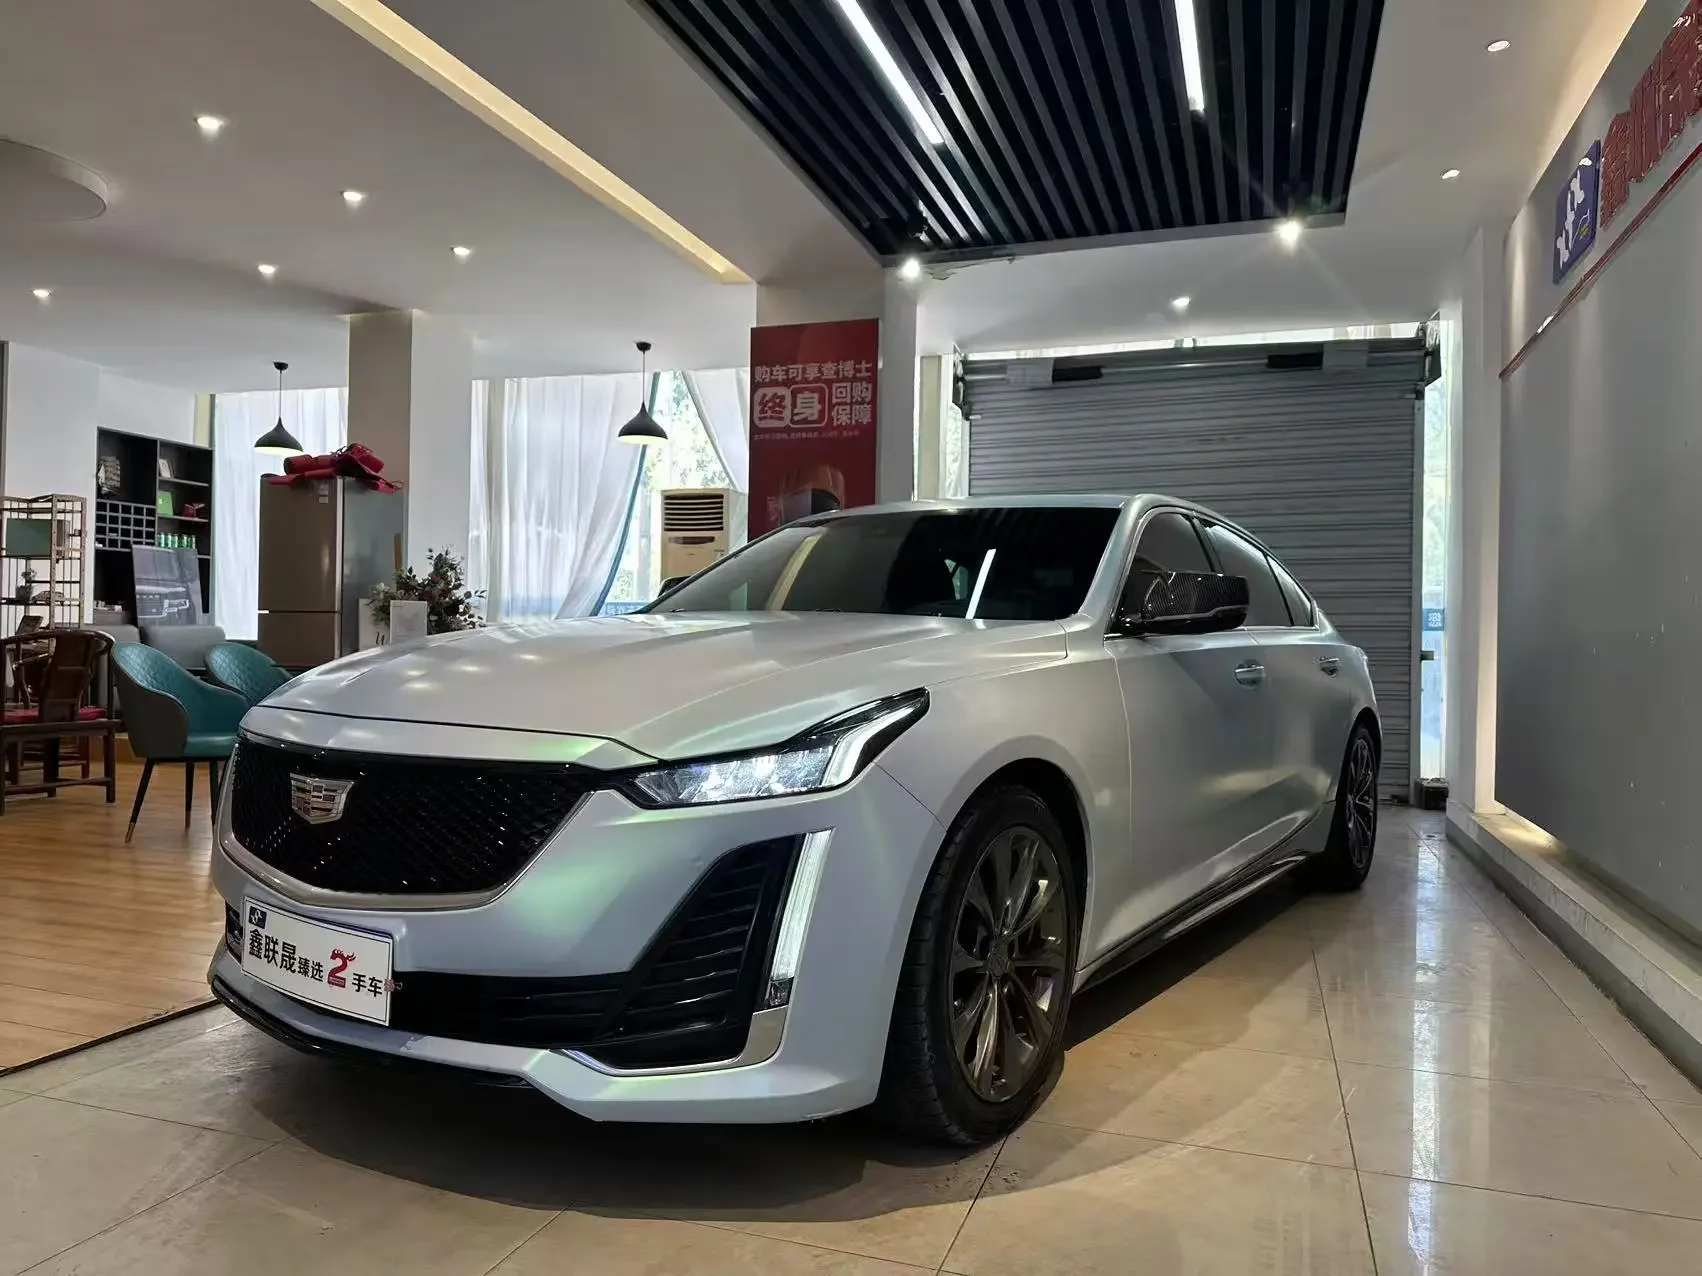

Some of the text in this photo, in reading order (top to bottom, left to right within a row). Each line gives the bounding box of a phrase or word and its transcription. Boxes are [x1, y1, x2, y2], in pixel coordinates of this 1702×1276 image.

[754, 361, 872, 382] 购车可享查博士
[832, 382, 872, 403] 回购
[758, 391, 822, 422] 终身
[832, 405, 872, 426] 保障
